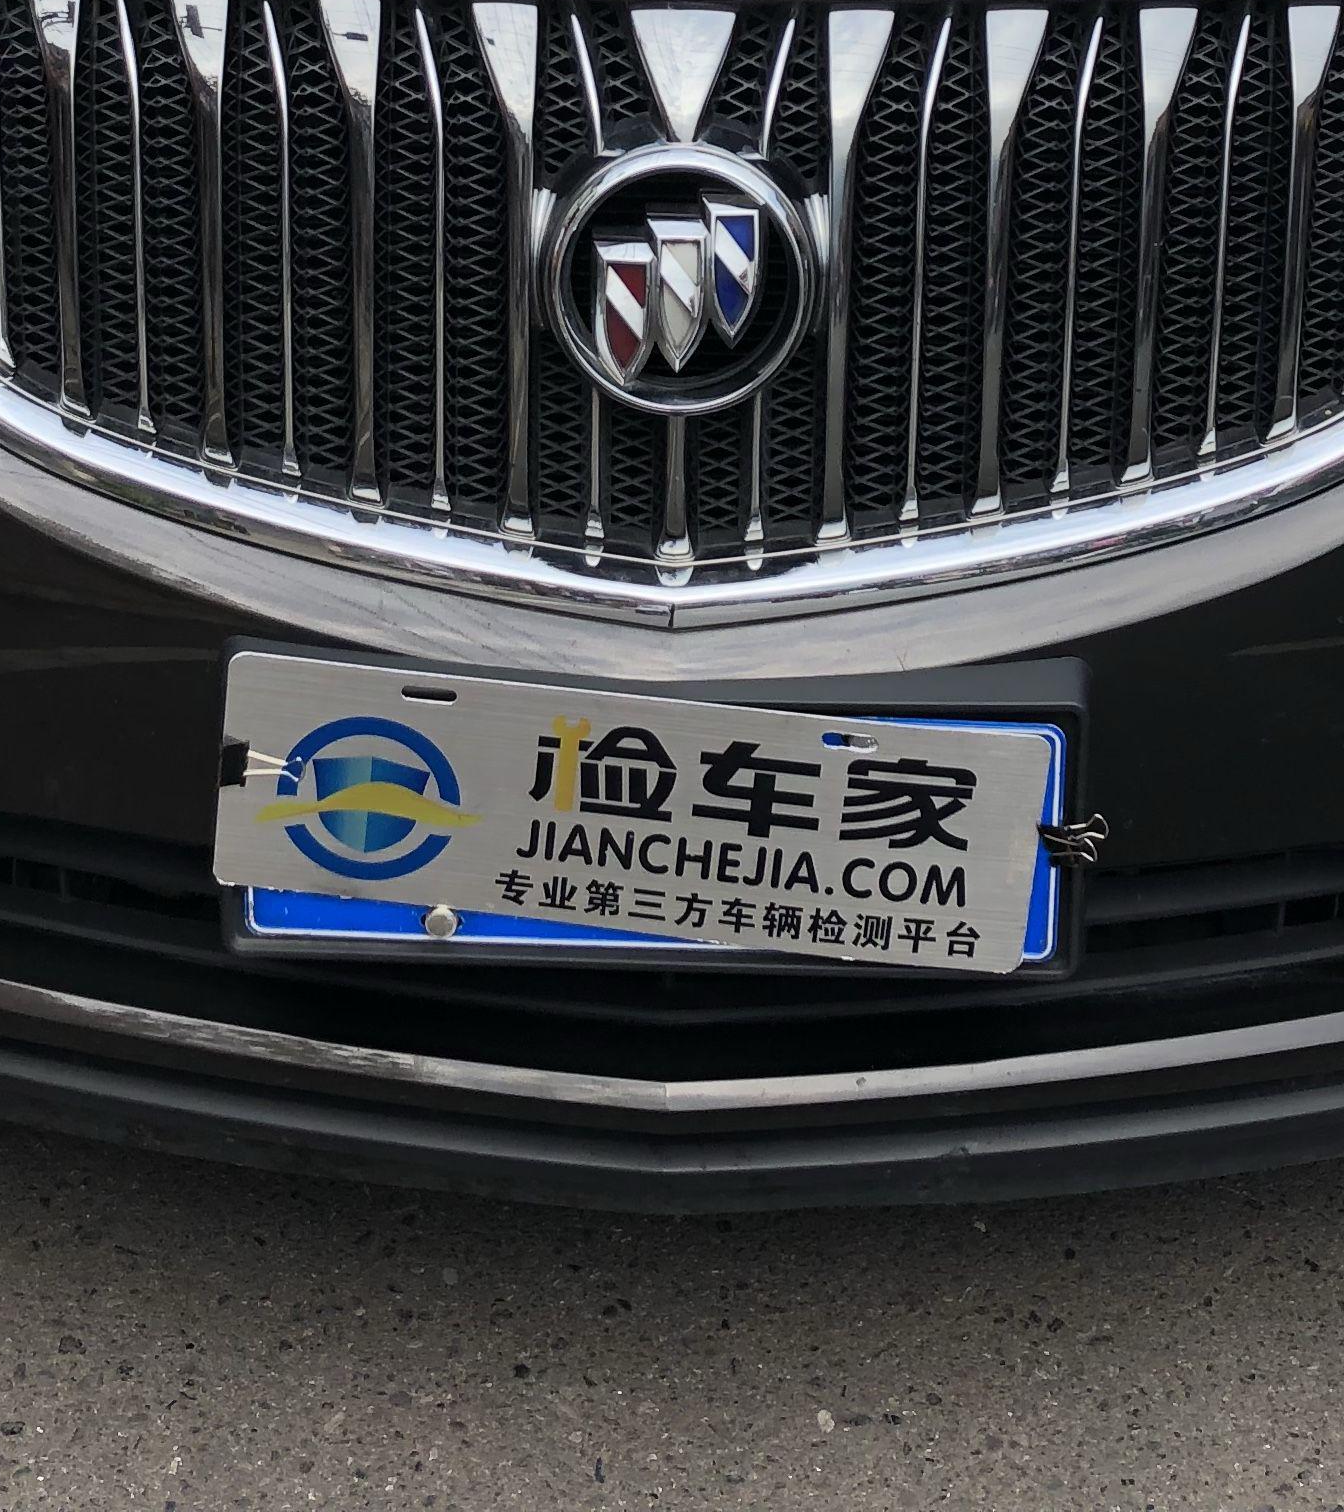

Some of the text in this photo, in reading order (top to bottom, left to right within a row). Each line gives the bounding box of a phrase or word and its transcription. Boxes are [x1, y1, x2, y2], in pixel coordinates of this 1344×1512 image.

[529, 715, 977, 851] 检车家
[516, 819, 967, 908] JIANCHEJIA.COM
[493, 868, 982, 958] 专业第三方车辆检测平台
